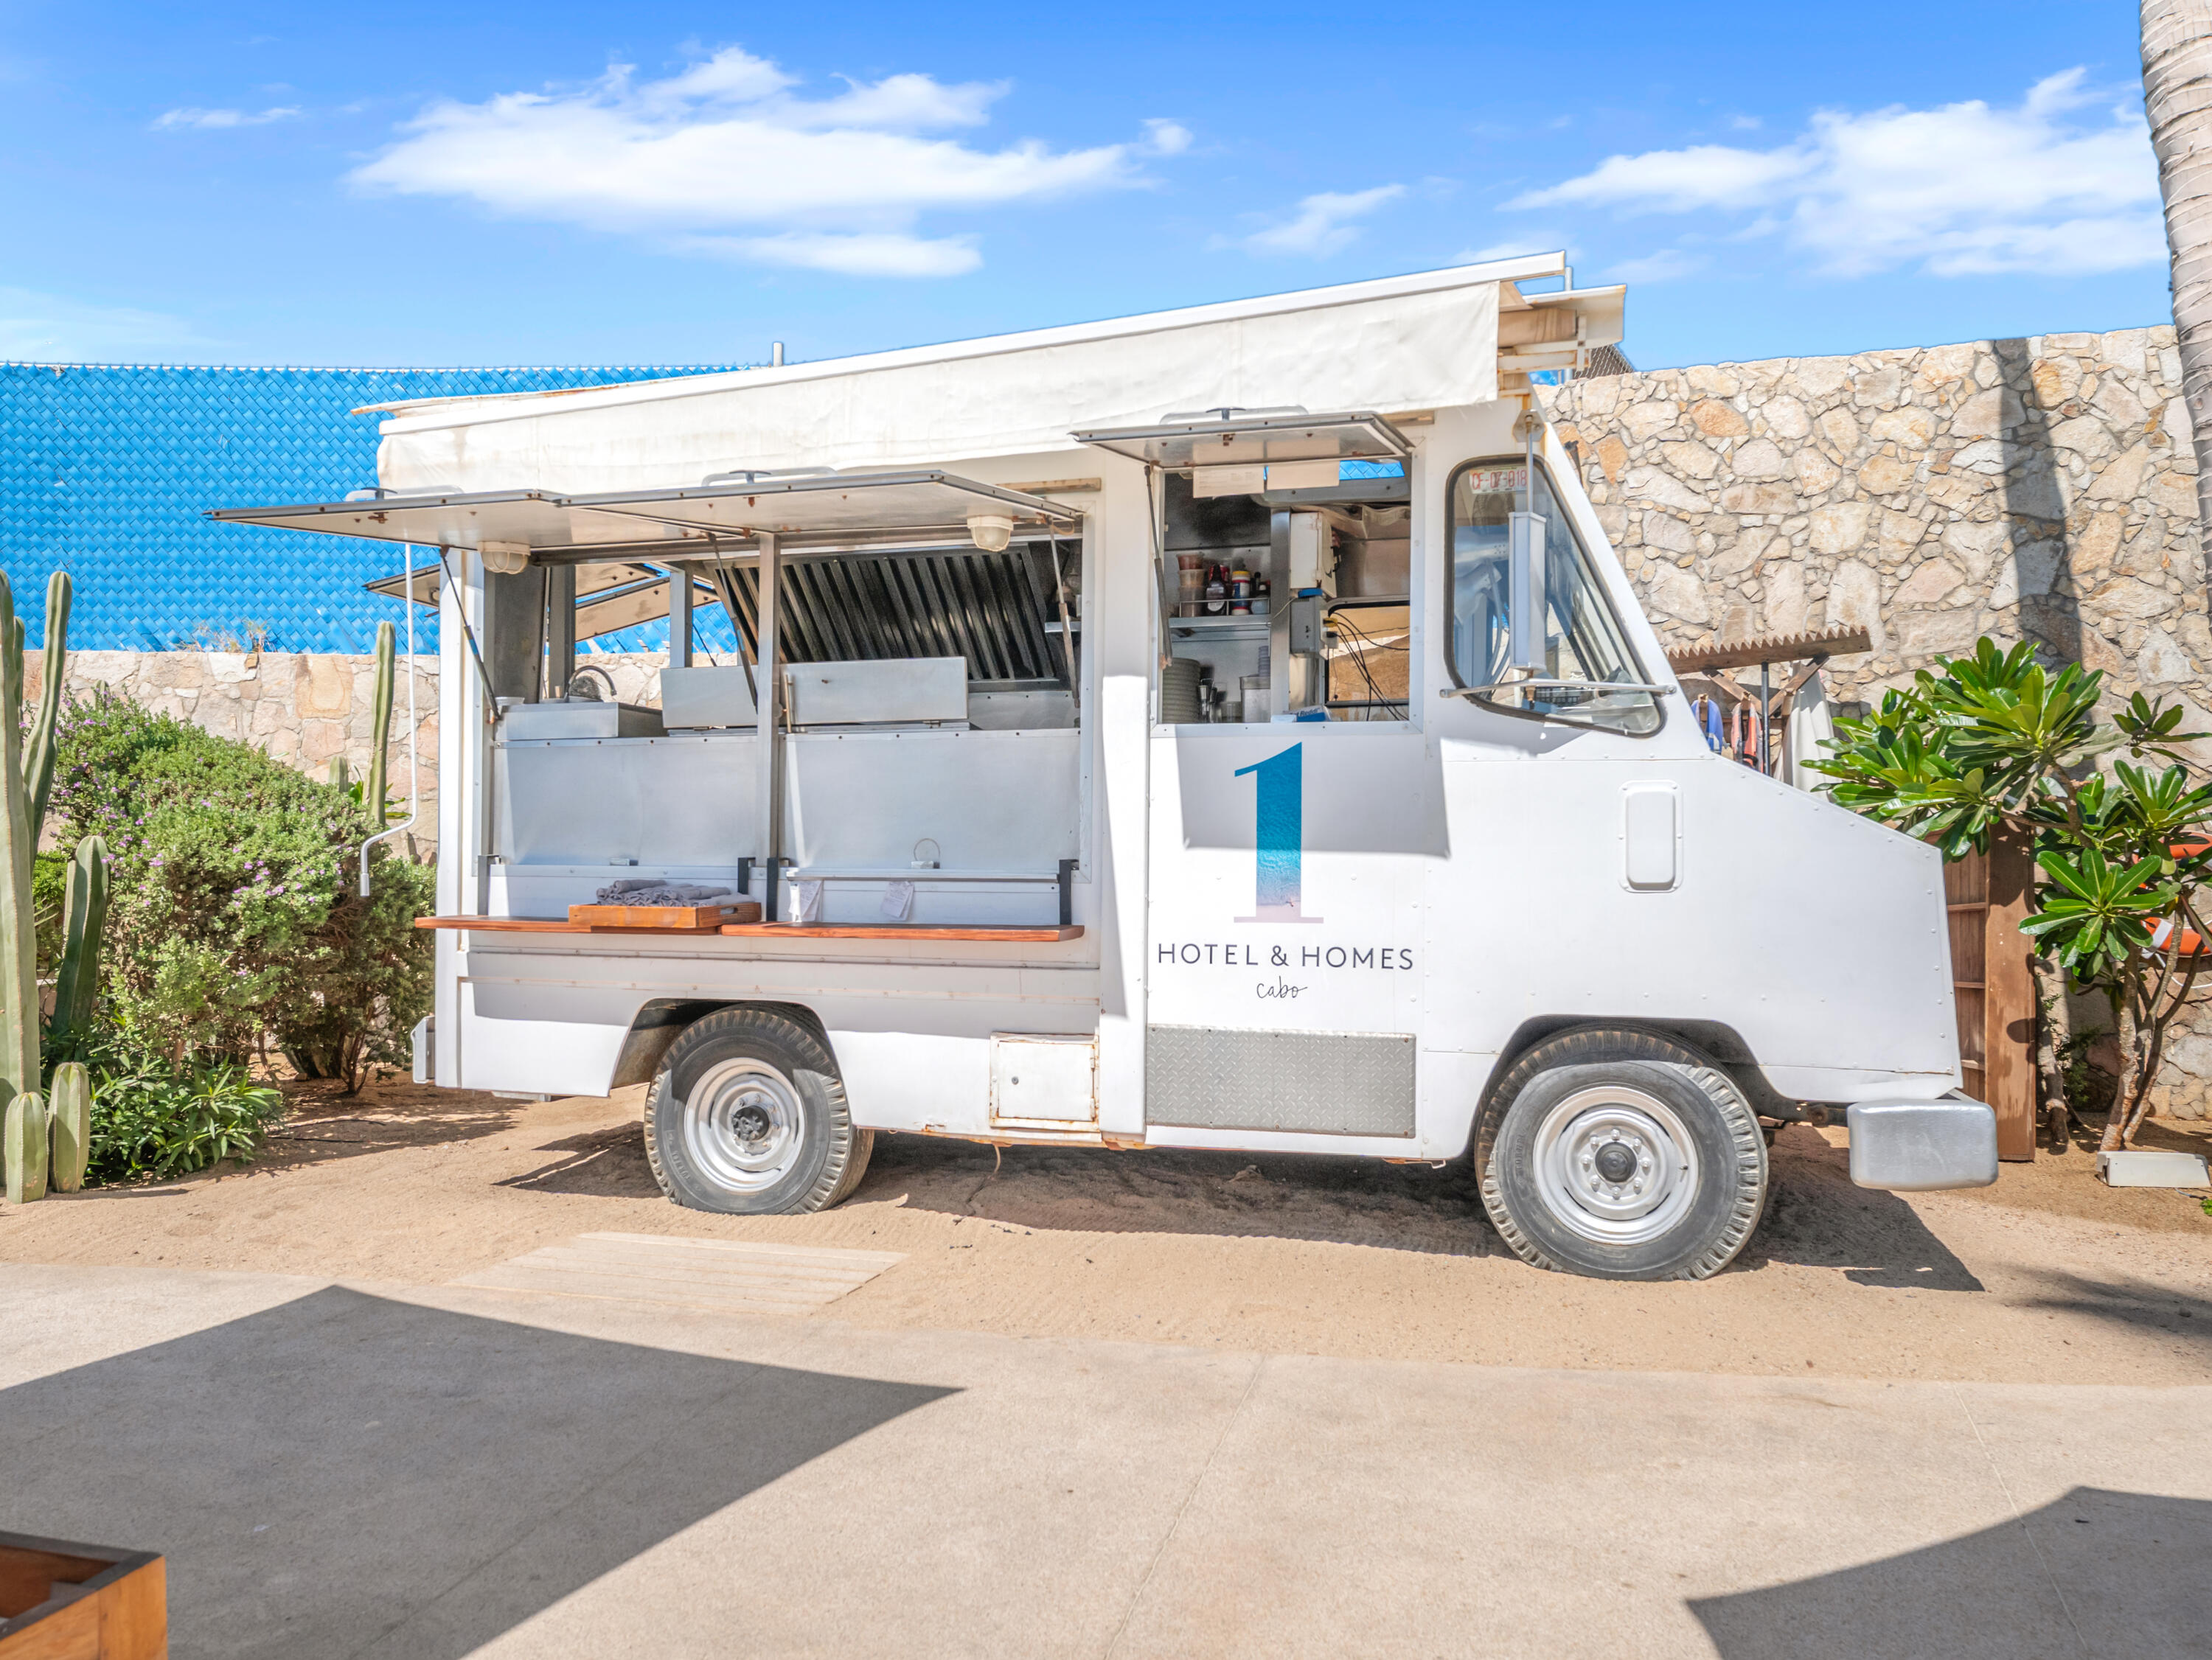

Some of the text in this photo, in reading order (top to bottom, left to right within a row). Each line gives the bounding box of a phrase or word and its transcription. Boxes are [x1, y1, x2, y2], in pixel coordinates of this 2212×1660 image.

[1234, 742, 1324, 924] 1
[1158, 943, 1413, 971] HOTEL & HOMES
[1256, 975, 1308, 999] cabo
